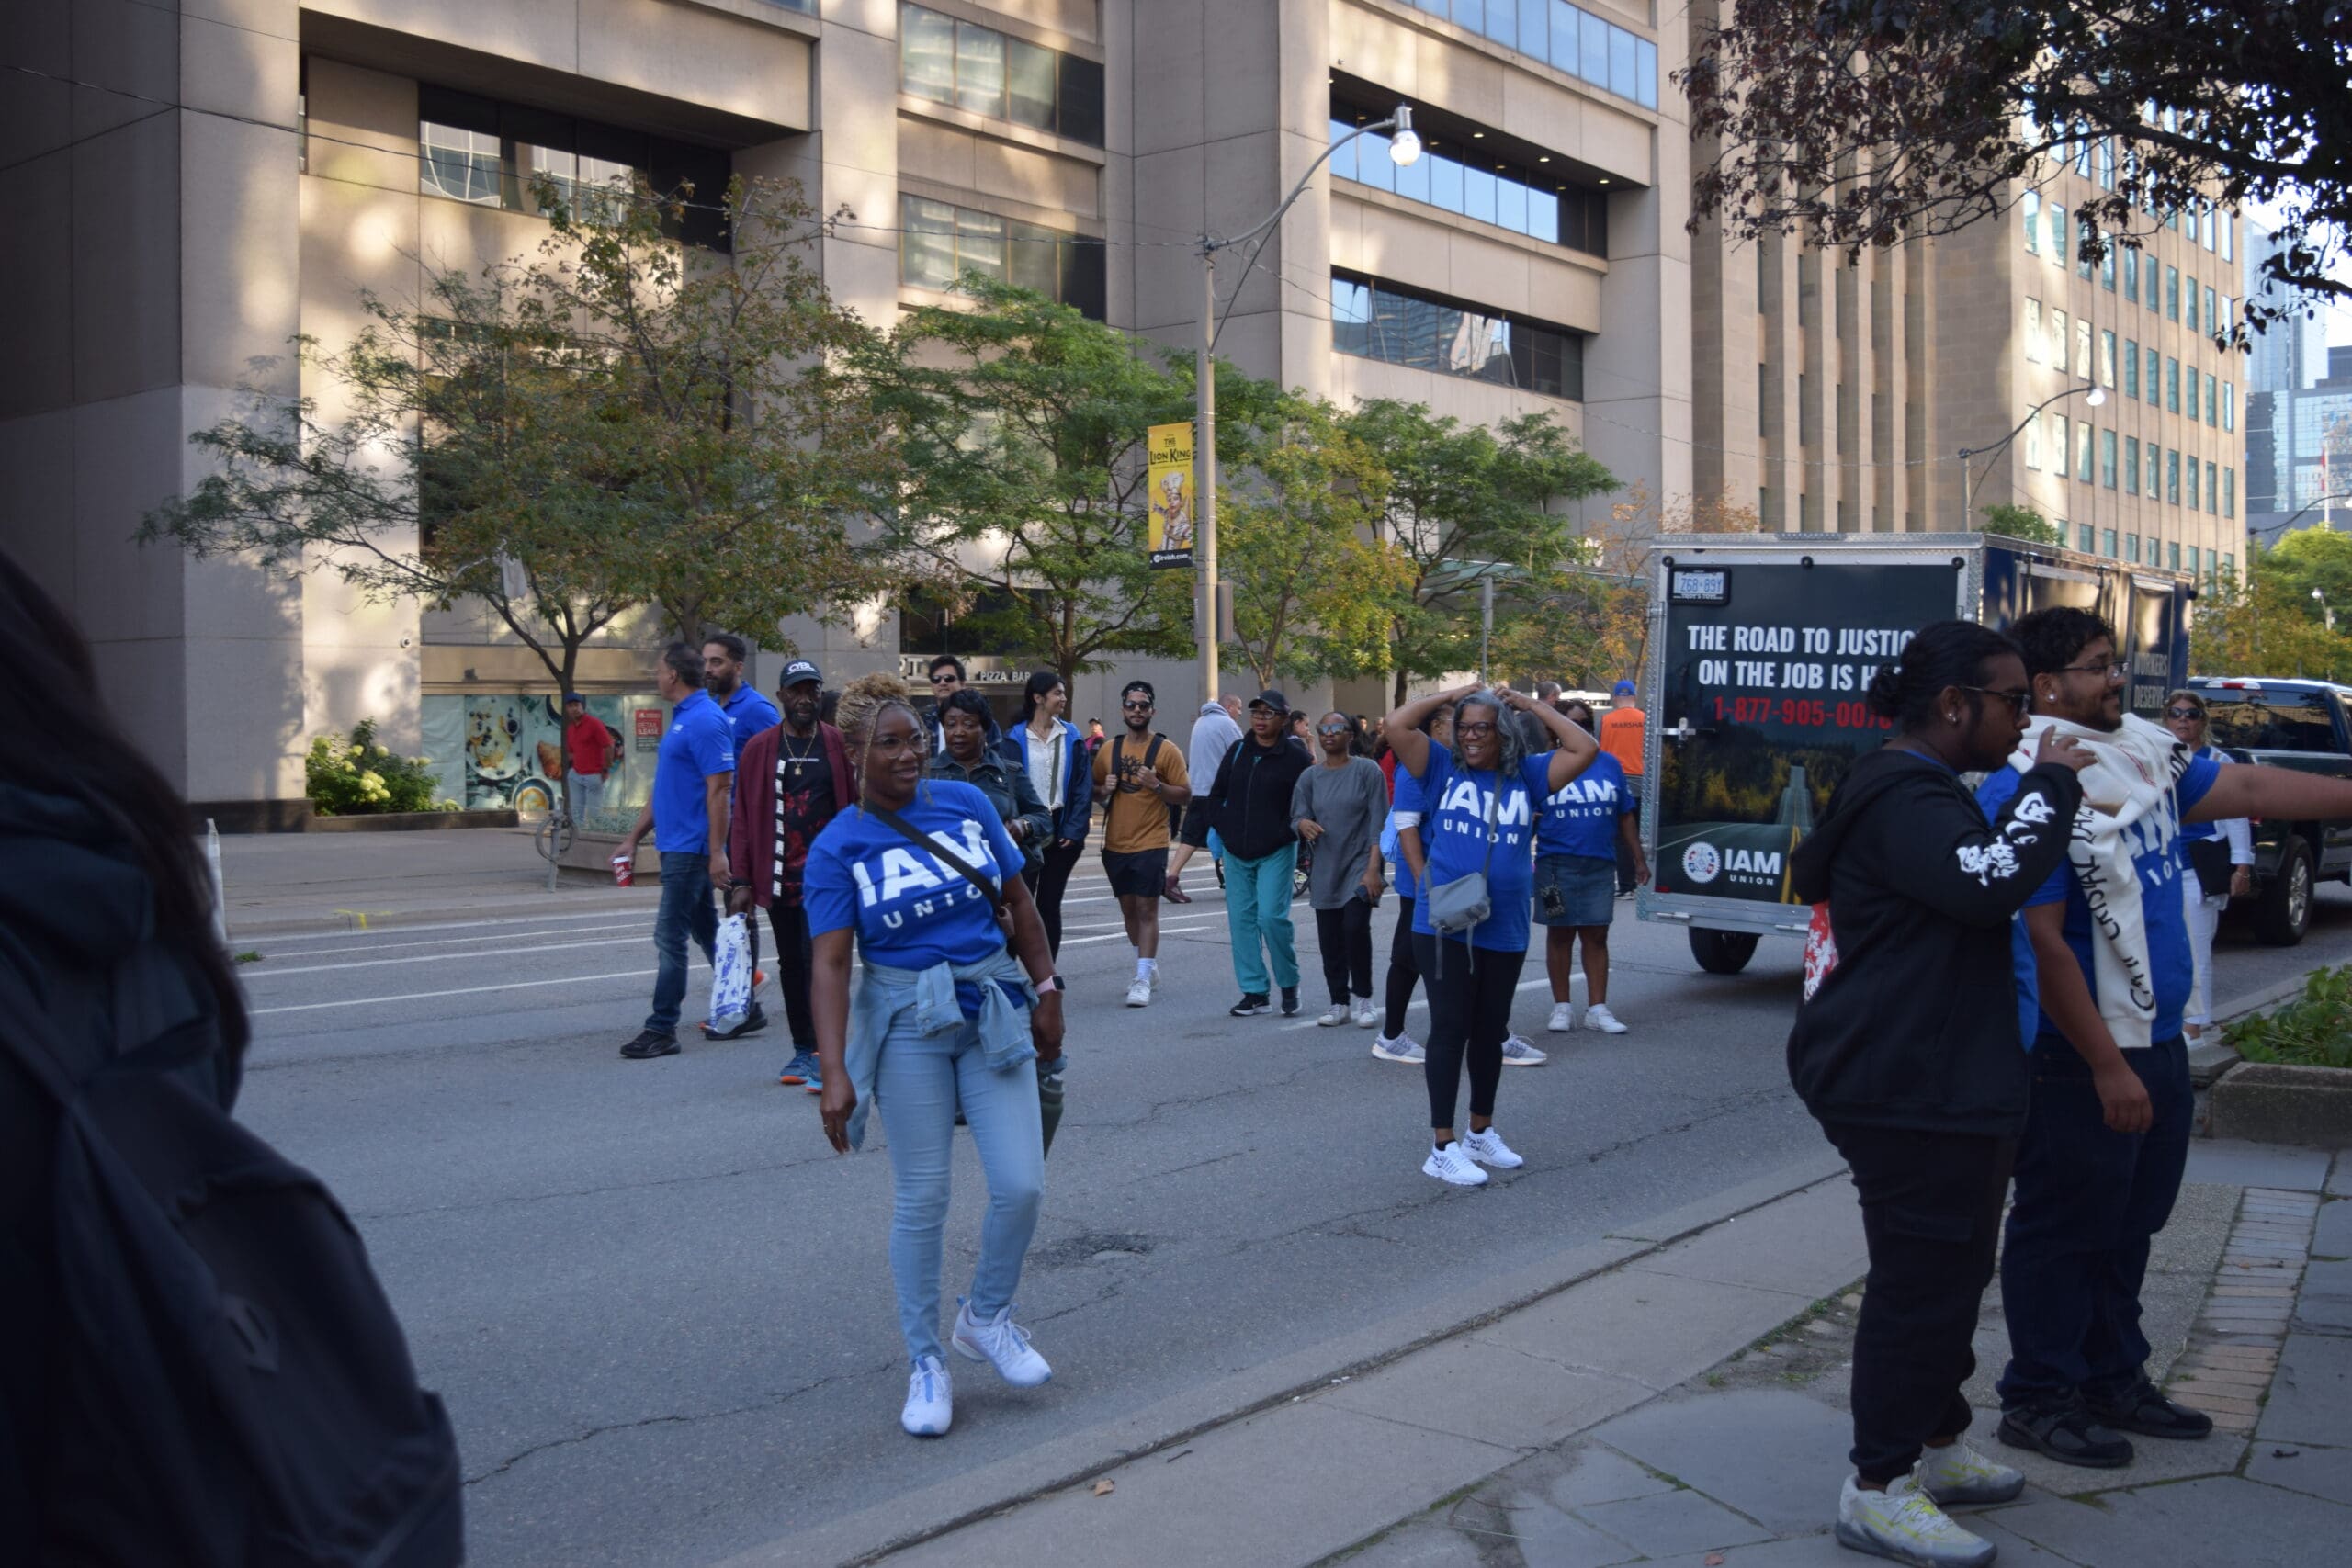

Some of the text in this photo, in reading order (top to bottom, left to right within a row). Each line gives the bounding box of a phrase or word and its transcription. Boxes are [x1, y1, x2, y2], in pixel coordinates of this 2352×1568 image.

[1164, 437, 1176, 446] THE
[1149, 448, 1192, 465] LION KING
[1688, 625, 1916, 656] THE ROAD TO JUSTIC
[979, 671, 1008, 682] PIZZA
[1012, 671, 1031, 682] BAR
[1698, 660, 1728, 686] ON
[1735, 660, 1776, 688] THE
[1781, 662, 1824, 690] JOB
[1830, 664, 1853, 691] IS
[1439, 776, 1529, 826] IAM
[1555, 807, 1612, 818] UNION
[1443, 818, 1519, 845] UNION
[853, 818, 997, 908] IAM
[1724, 848, 1781, 874] IAM
[1729, 874, 1774, 886] UNION
[882, 874, 1002, 929] UNION
